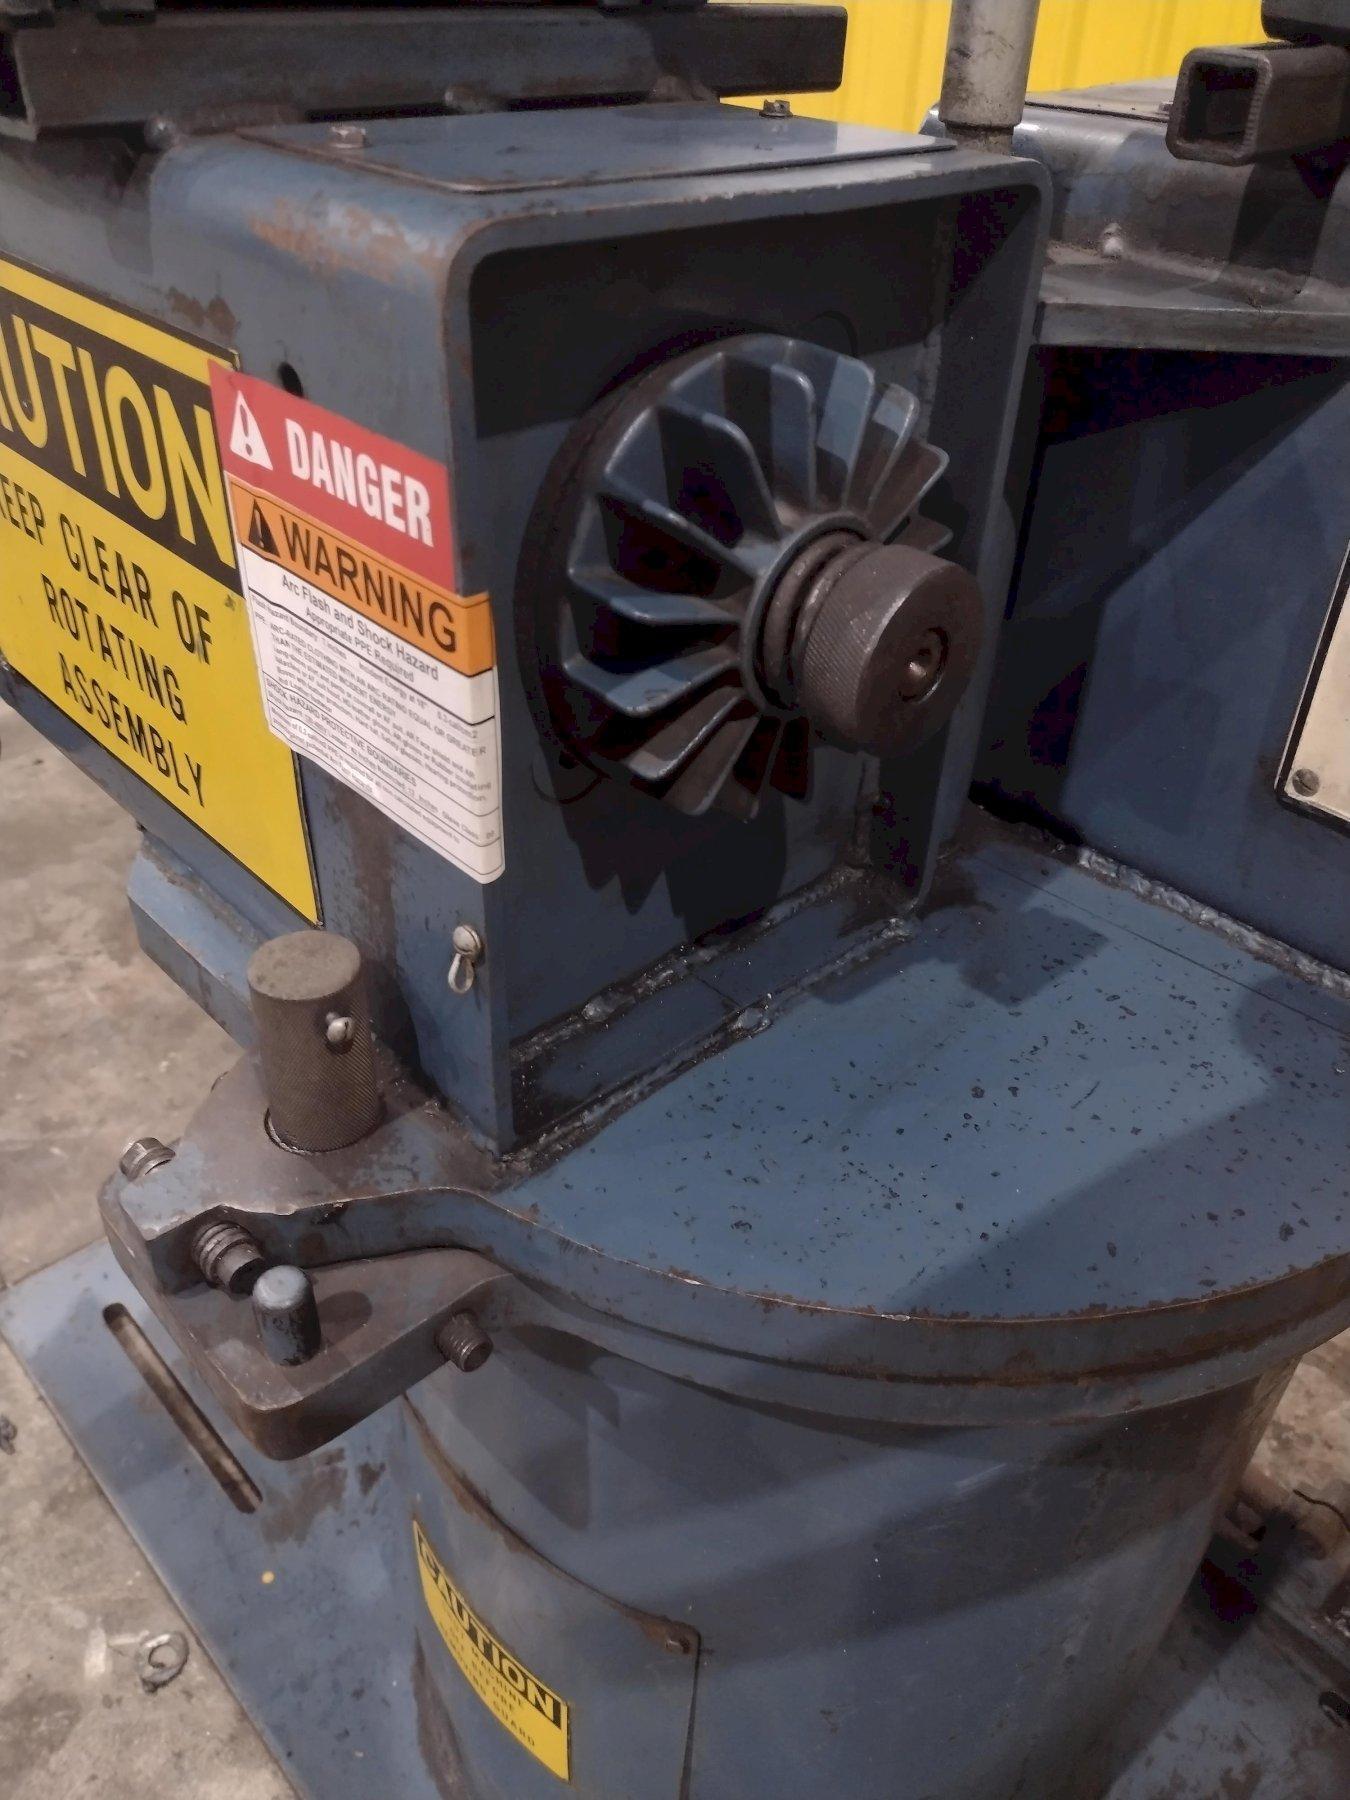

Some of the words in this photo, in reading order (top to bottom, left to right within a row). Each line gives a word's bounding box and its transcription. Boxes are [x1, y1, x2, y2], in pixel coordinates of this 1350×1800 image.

[0, 314, 235, 570] UTION
[285, 417, 434, 548] DANGER
[0, 474, 46, 545] EEP
[60, 513, 159, 628] CLEAR
[172, 590, 213, 665] OF
[280, 572, 299, 596] Arc
[301, 585, 331, 615] Flash
[333, 603, 354, 630] and
[356, 618, 393, 654] Shock
[395, 641, 438, 682] Hazard
[281, 514, 457, 654] WARNING
[41, 573, 188, 725] ROTATING
[305, 605, 352, 646] Appropriate
[354, 635, 372, 657] PPE
[373, 648, 414, 683] Required
[59, 652, 205, 808] ASSEMBLY
[266, 677, 287, 700] SHOCK
[289, 691, 320, 720] HAZARD
[320, 713, 365, 751] PROTECTIVE
[366, 744, 416, 787] BOUNDARIES
[418, 1536, 555, 1722] CAUTION
